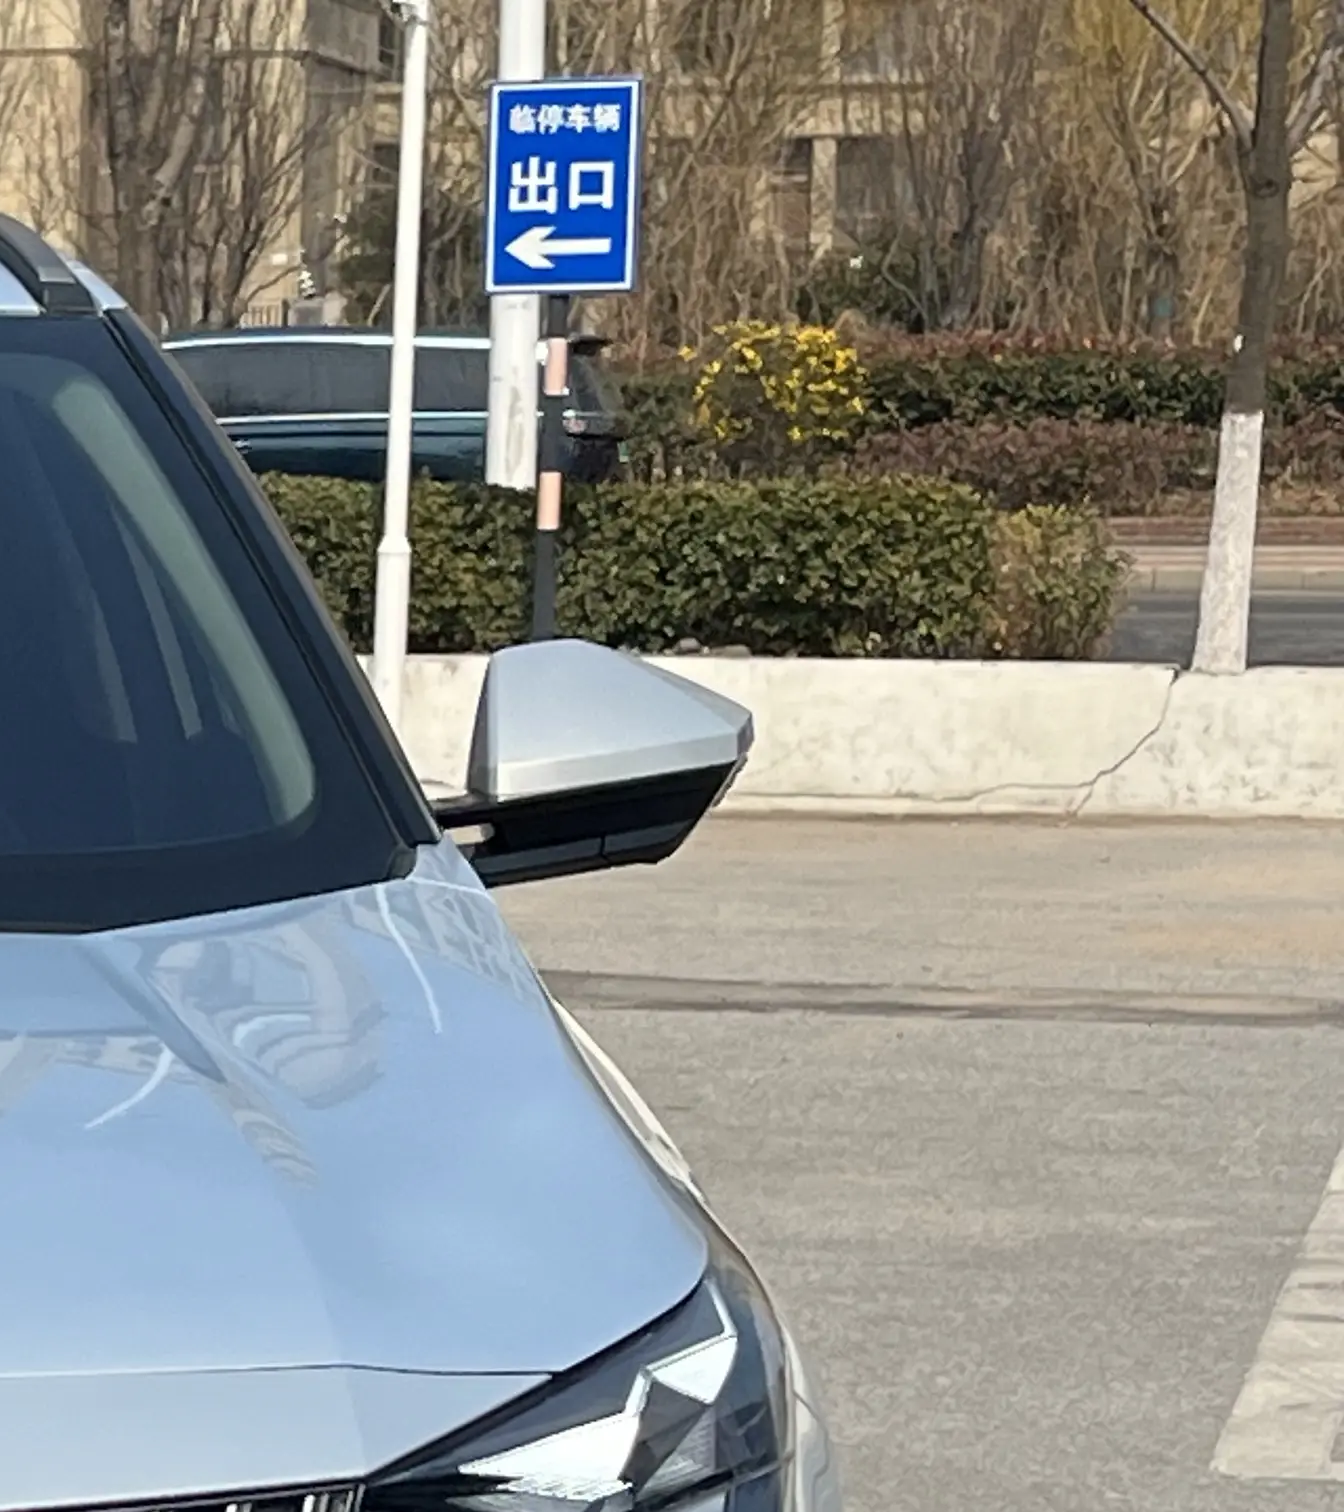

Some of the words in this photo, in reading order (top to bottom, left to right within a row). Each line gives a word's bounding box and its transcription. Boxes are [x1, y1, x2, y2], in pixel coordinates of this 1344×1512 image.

[509, 103, 621, 134] 临停车辆
[508, 156, 615, 214] 出口
